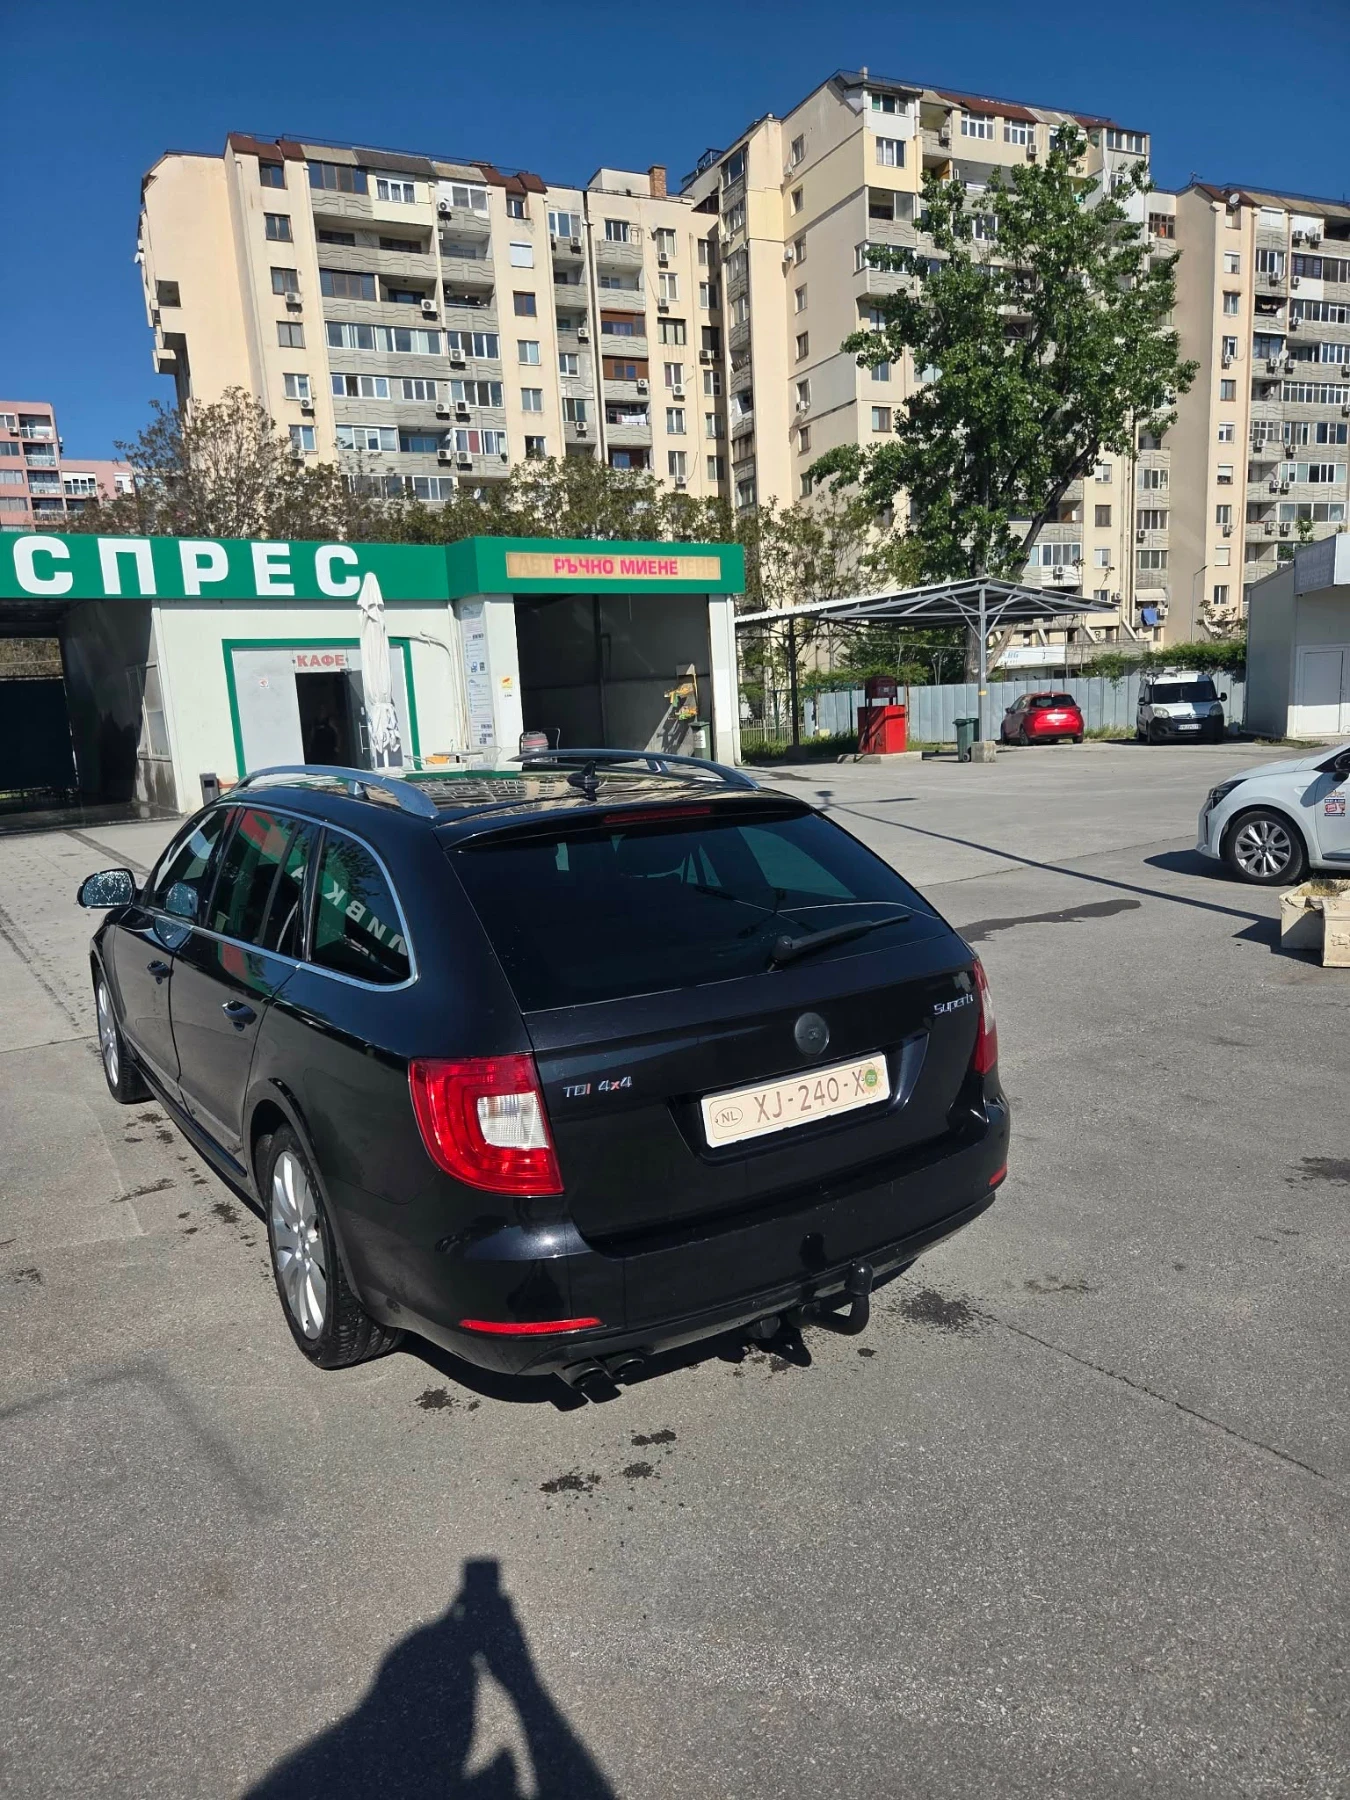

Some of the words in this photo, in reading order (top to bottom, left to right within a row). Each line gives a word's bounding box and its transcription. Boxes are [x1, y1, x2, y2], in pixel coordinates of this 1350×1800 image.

[13, 535, 361, 597] СПРЕС
[554, 557, 614, 574] РЪЧНО
[620, 559, 678, 575] МИЕНЕ
[297, 655, 345, 667] КАФЕ
[563, 1083, 591, 1097] TDI
[598, 1076, 633, 1091] 4x4
[754, 1069, 865, 1123] XJ-240-X
[721, 1111, 738, 1123] NL
